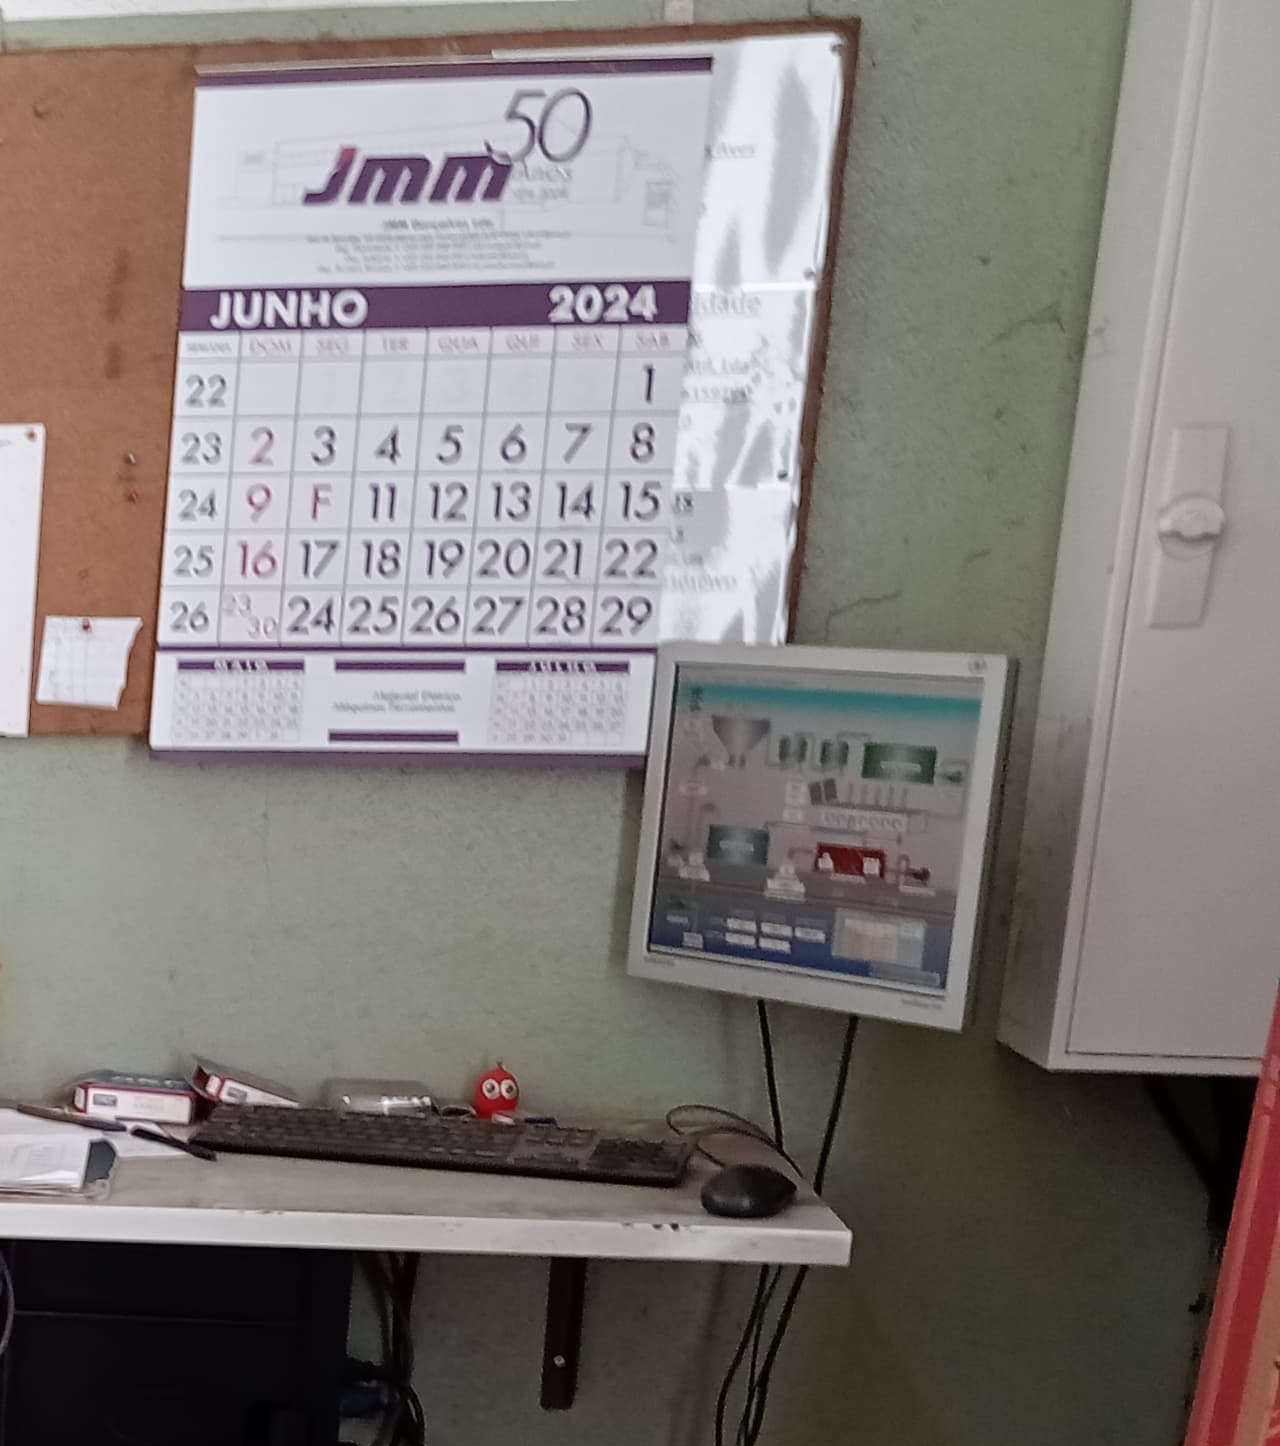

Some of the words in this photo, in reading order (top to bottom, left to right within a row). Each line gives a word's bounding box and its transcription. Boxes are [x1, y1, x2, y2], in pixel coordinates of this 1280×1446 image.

[484, 86, 592, 164] 50
[209, 288, 369, 330] JUNHO
[547, 283, 658, 323] 2024
[184, 373, 227, 408] 22
[643, 363, 655, 404] 1
[180, 431, 223, 466] 23
[248, 423, 275, 466] 2
[311, 423, 337, 466] 3
[374, 423, 401, 466] 4
[436, 423, 464, 466] 5
[500, 423, 528, 466] 6
[561, 423, 593, 466] 7
[629, 423, 657, 466] 8
[176, 488, 218, 522] 24
[246, 481, 273, 522] 9
[312, 481, 333, 522] F
[368, 481, 398, 522] 11
[428, 481, 469, 522] 12
[491, 481, 533, 522] 13
[555, 481, 596, 522] 14
[619, 481, 663, 522] 15
[173, 544, 214, 577] 25
[237, 538, 279, 579] 16
[300, 538, 341, 579] 17
[361, 538, 402, 579] 18
[424, 538, 466, 579] 19
[477, 538, 531, 579] 20
[542, 538, 584, 579] 21
[603, 538, 659, 579] 22
[168, 600, 210, 634] 26
[286, 595, 337, 636] 24
[346, 595, 400, 636] 25
[410, 595, 461, 636] 26
[472, 595, 527, 636] 27
[535, 595, 587, 636] 28
[598, 595, 653, 636] 29
